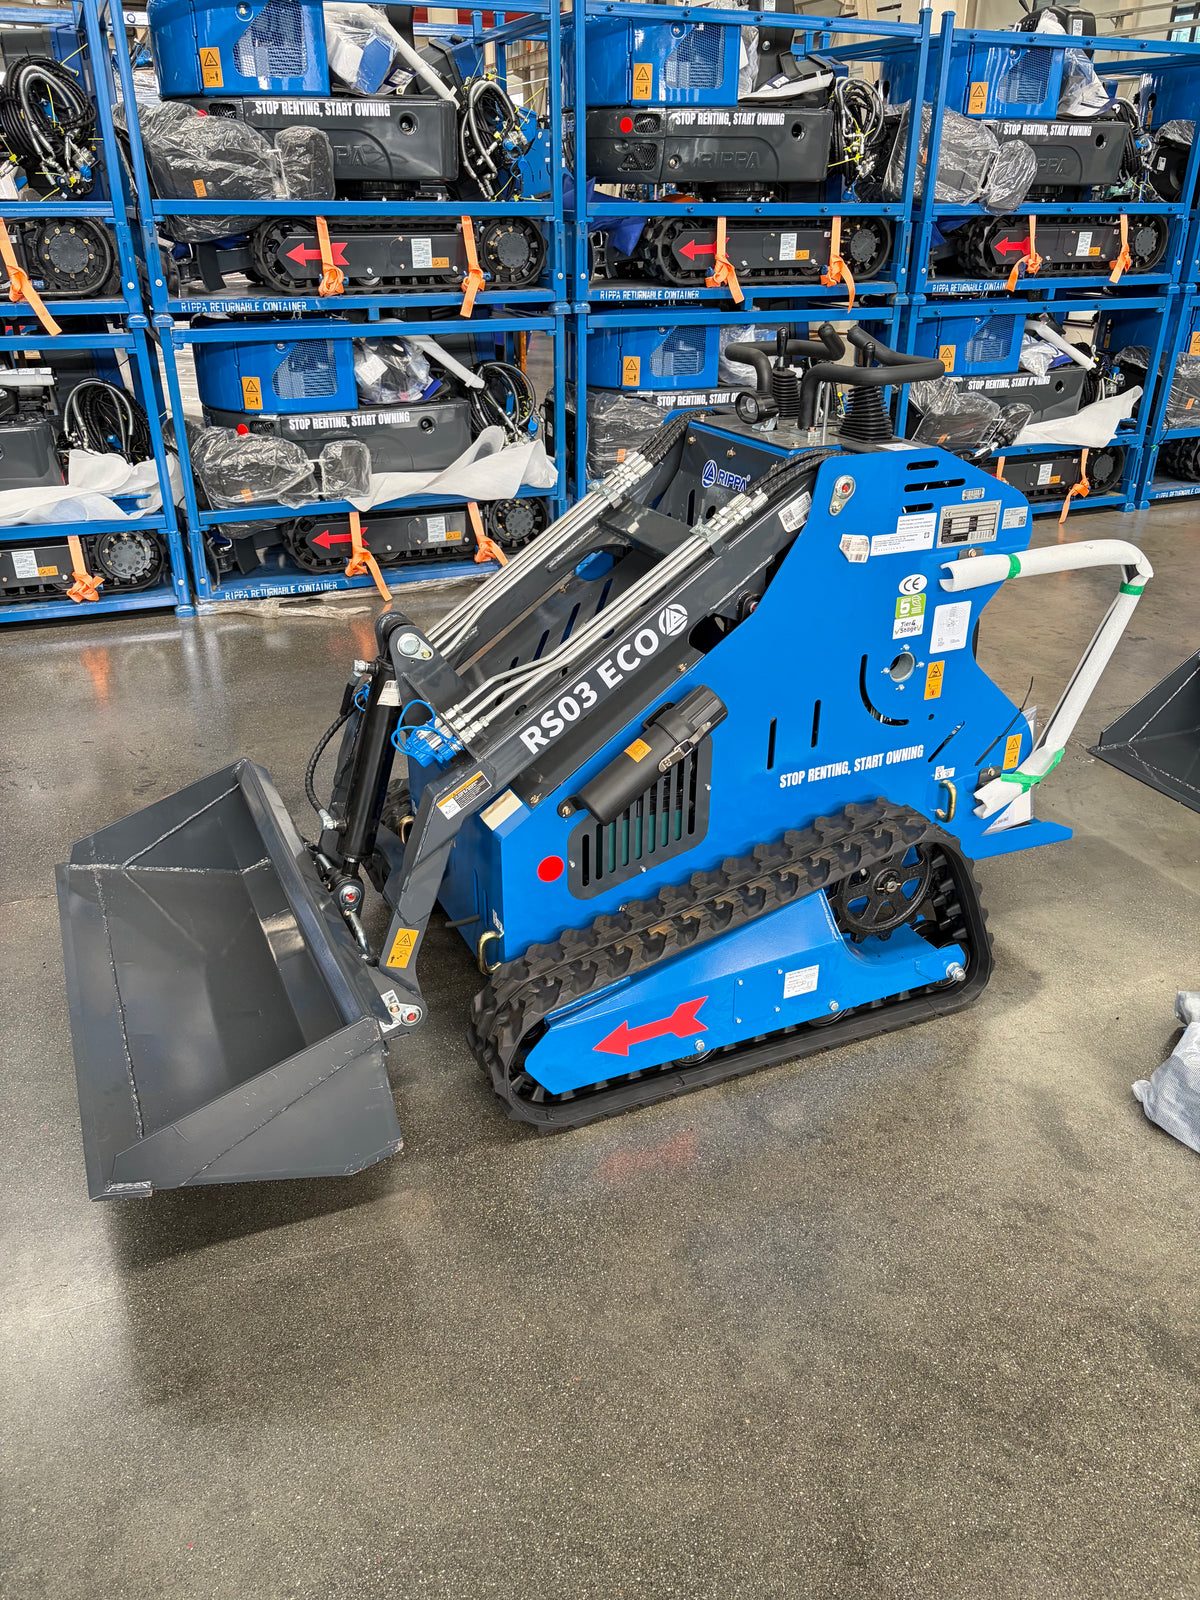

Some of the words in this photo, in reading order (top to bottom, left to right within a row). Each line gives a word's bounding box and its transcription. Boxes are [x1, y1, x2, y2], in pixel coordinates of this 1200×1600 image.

[256, 100, 279, 114] STOP
[282, 101, 323, 117] RENTING,
[325, 102, 353, 116] START
[355, 103, 391, 117] OWNING
[675, 112, 696, 125] STOP
[733, 113, 755, 125] START
[757, 113, 785, 126] OWNING
[1003, 124, 1021, 135] STOP
[1049, 124, 1069, 136] START
[1069, 125, 1092, 136] OWNING
[600, 290, 620, 300] RIPPA
[664, 290, 700, 300] CONTAINER
[181, 302, 208, 312] RIPPA
[210, 302, 260, 312] RETURNABLE
[263, 301, 307, 311] CONTAINER
[968, 380, 985, 391] STOP
[1011, 377, 1029, 388] START
[657, 396, 676, 406] STOP
[709, 392, 730, 404] START
[289, 418, 310, 430] STOP
[312, 416, 350, 429] RENTING,
[351, 414, 377, 427] START
[378, 412, 410, 424] OWNING
[225, 590, 248, 600] RIPPA
[250, 586, 296, 598] RETURNABLE
[298, 582, 338, 592] CONTAINER
[904, 577, 920, 592] CE
[519, 681, 598, 755] RS03
[596, 628, 659, 690] ECO
[779, 770, 806, 789] STOP
[808, 761, 852, 783] RENTING,
[854, 753, 884, 772] START
[886, 744, 924, 765] OWNING
